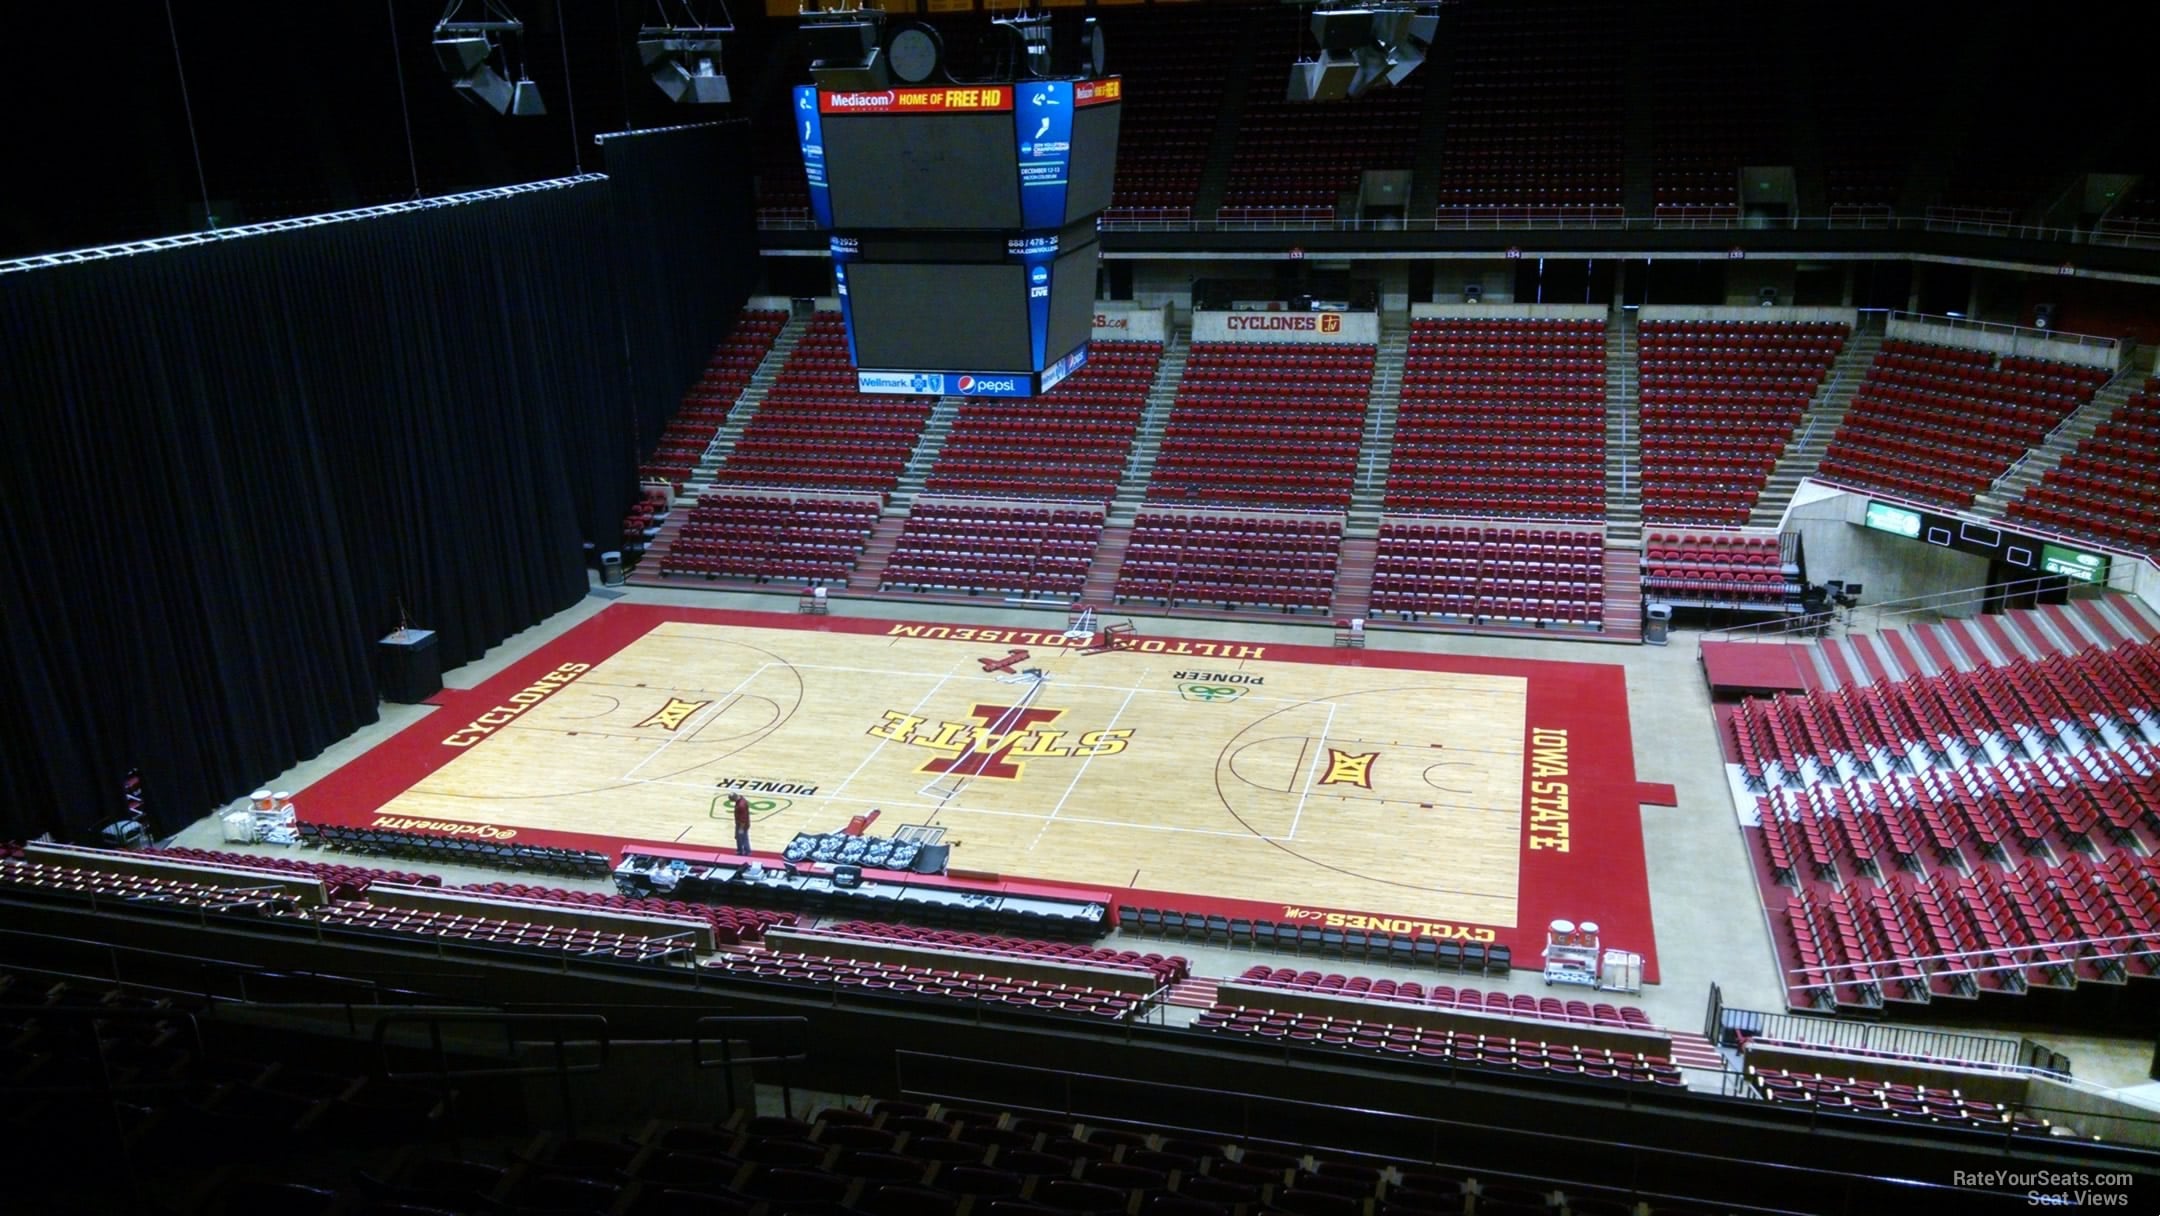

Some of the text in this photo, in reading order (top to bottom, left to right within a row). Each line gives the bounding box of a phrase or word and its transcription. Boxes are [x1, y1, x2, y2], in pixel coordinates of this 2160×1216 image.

[831, 88, 1000, 107] Mediacom HOME OF FREE HD
[1227, 316, 1316, 331] CYCLONES
[859, 377, 1015, 393] Wellmark pepsi
[888, 624, 1094, 647] COLISEUM
[1172, 670, 1265, 686] PIONEER
[441, 661, 591, 748] CYCLONES
[867, 711, 1136, 758] STATE
[716, 778, 819, 796] PIONEER
[1529, 727, 1570, 853] IOWA STATE
[373, 816, 517, 840] @CycloneATH
